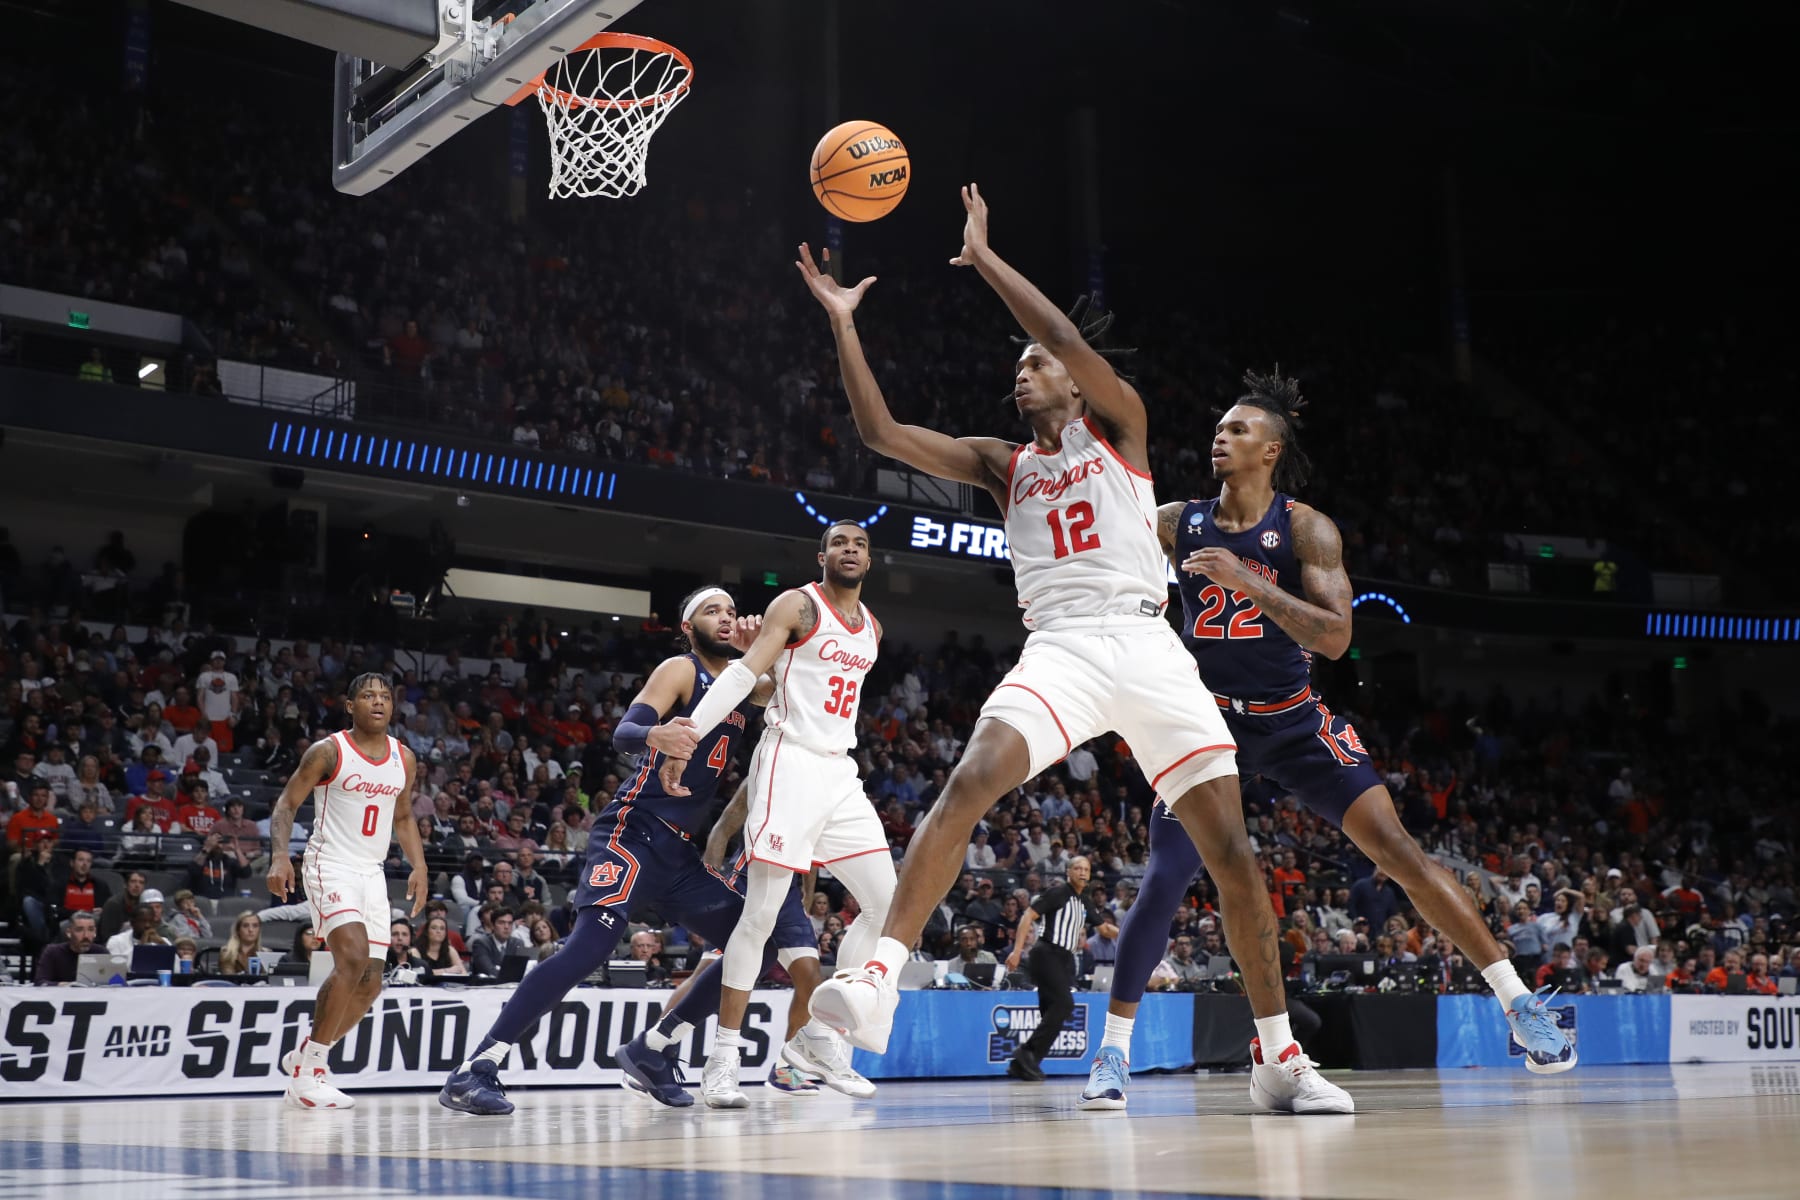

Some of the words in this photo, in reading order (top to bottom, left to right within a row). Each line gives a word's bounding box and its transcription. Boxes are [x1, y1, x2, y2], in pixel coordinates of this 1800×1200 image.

[869, 165, 907, 188] NCAA
[1014, 457, 1104, 504] Cougars
[1046, 501, 1102, 560] 12
[1261, 531, 1280, 548] SEC
[1193, 584, 1264, 640] 22
[818, 639, 873, 672] Cougar
[824, 675, 858, 719] 32
[706, 734, 730, 778] 4
[361, 804, 380, 837] 0
[1010, 1009, 1043, 1030] MAR
[1689, 1020, 1725, 1035] HOSTED
[1727, 1020, 1740, 1035] BY
[103, 1025, 172, 1058] AND
[181, 998, 471, 1079] SECOND
[498, 1000, 772, 1071] OUS
[1018, 1030, 1086, 1051] MESS
